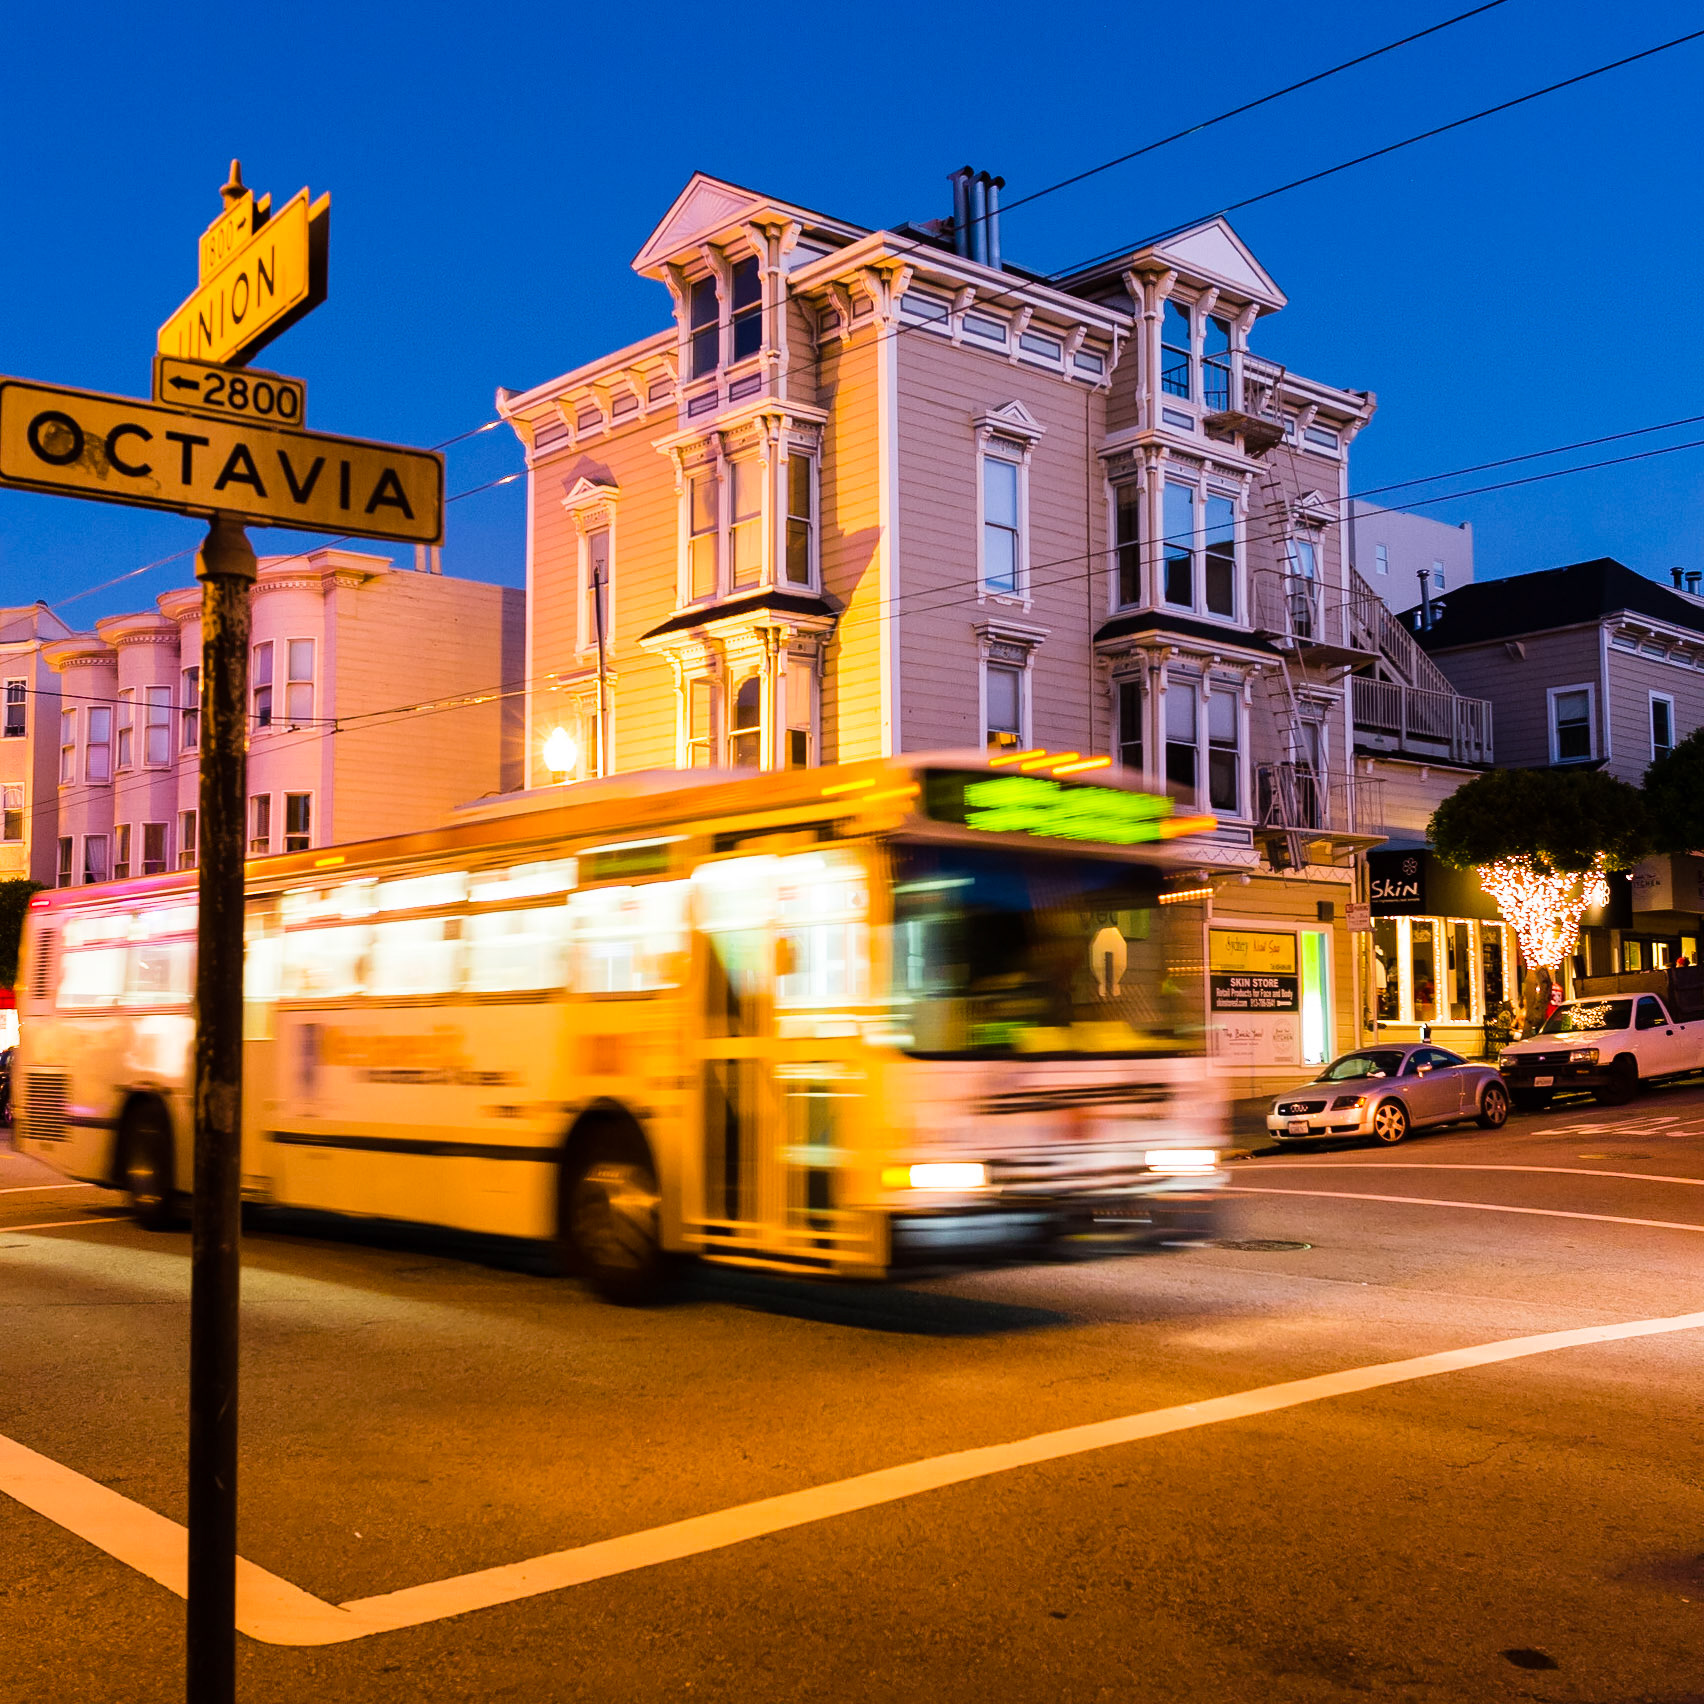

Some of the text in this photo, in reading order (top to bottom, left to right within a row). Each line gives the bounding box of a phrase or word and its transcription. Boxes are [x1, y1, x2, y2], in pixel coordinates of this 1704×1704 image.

[178, 244, 275, 359] UNION
[203, 372, 299, 420] 2800
[27, 410, 415, 520] OCTAVIA
[1216, 987, 1230, 997] Retail
[1231, 988, 1252, 998] Products
[1261, 988, 1271, 998] Face
[1282, 988, 1293, 1000] Body
[1230, 977, 1279, 988] SKIN STORE
